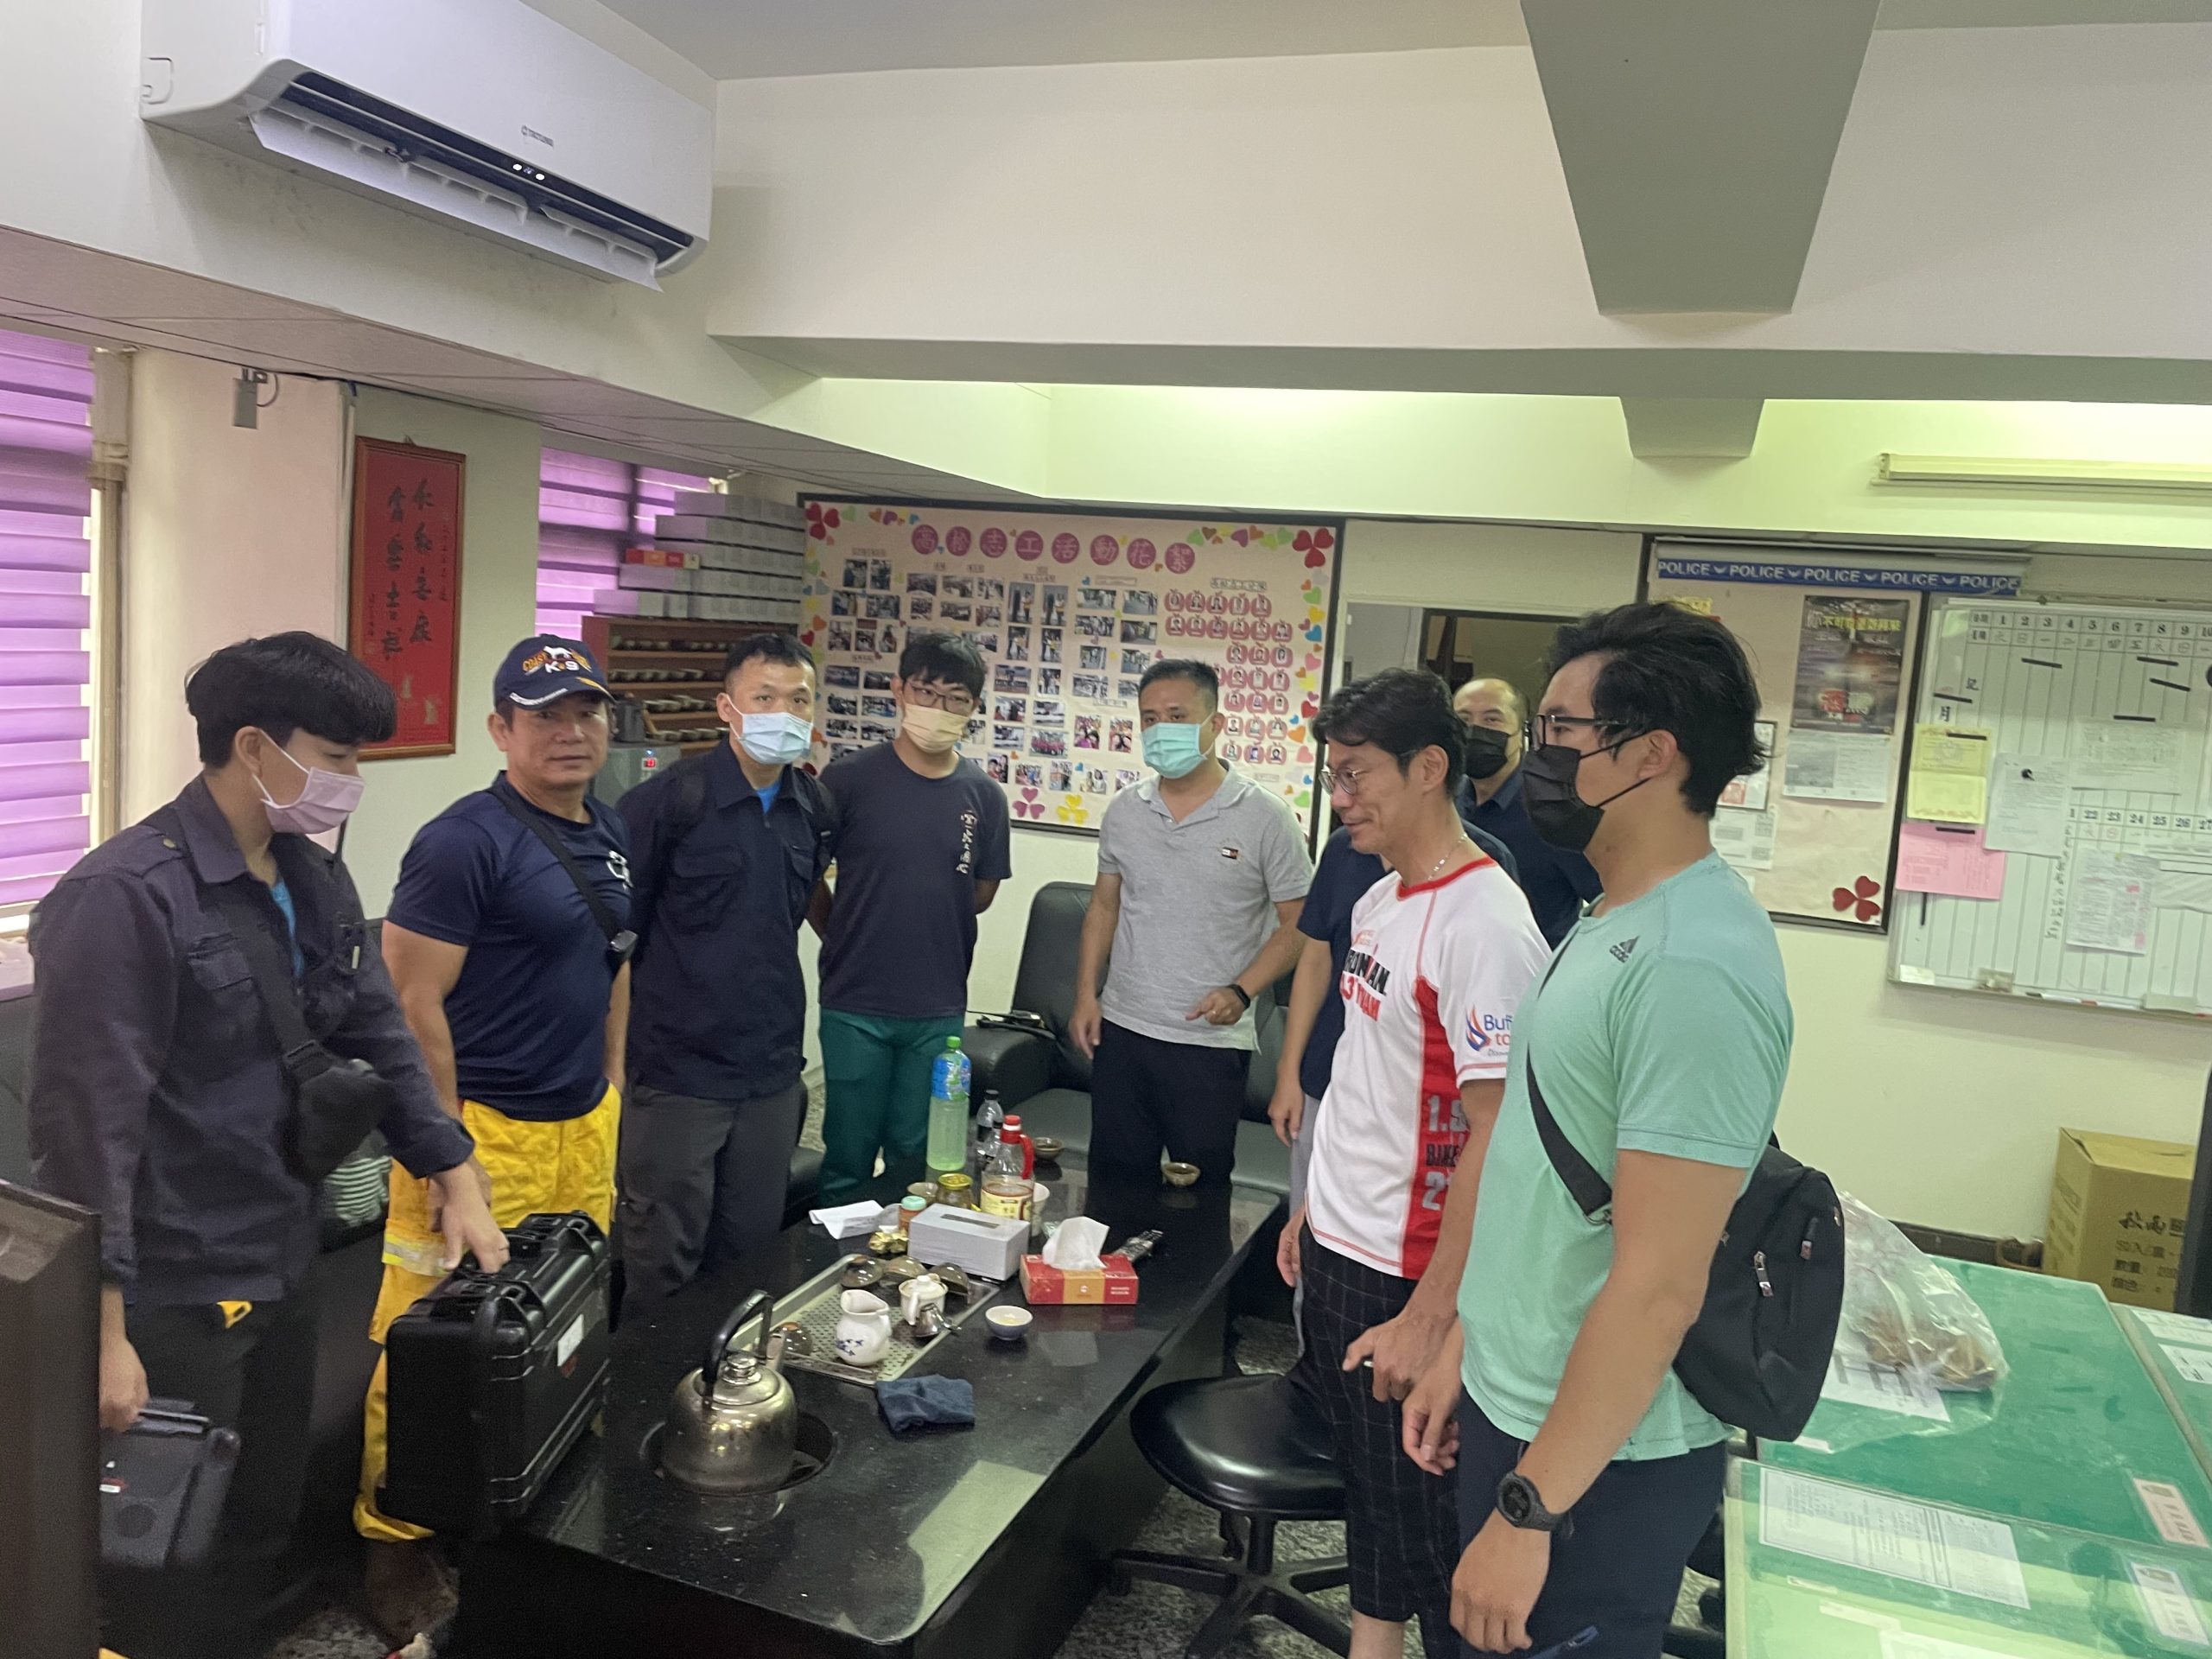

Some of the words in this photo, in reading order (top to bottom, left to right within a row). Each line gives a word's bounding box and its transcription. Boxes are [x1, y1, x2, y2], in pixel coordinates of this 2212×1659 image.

[1658, 561, 1710, 575] POLICE
[1729, 564, 1784, 579] POLICE
[1803, 568, 1860, 583] POLICE
[1880, 571, 1939, 587] POLICE
[1959, 575, 2018, 589] POLICE
[2021, 616, 2030, 626] 2
[2043, 617, 2052, 627] 3
[2066, 619, 2074, 629] 4
[2088, 620, 2097, 630] 5
[2134, 623, 2143, 632] 7
[2157, 624, 2166, 634] 8
[2181, 625, 2190, 635] 9
[1495, 1033, 1511, 1046] to
